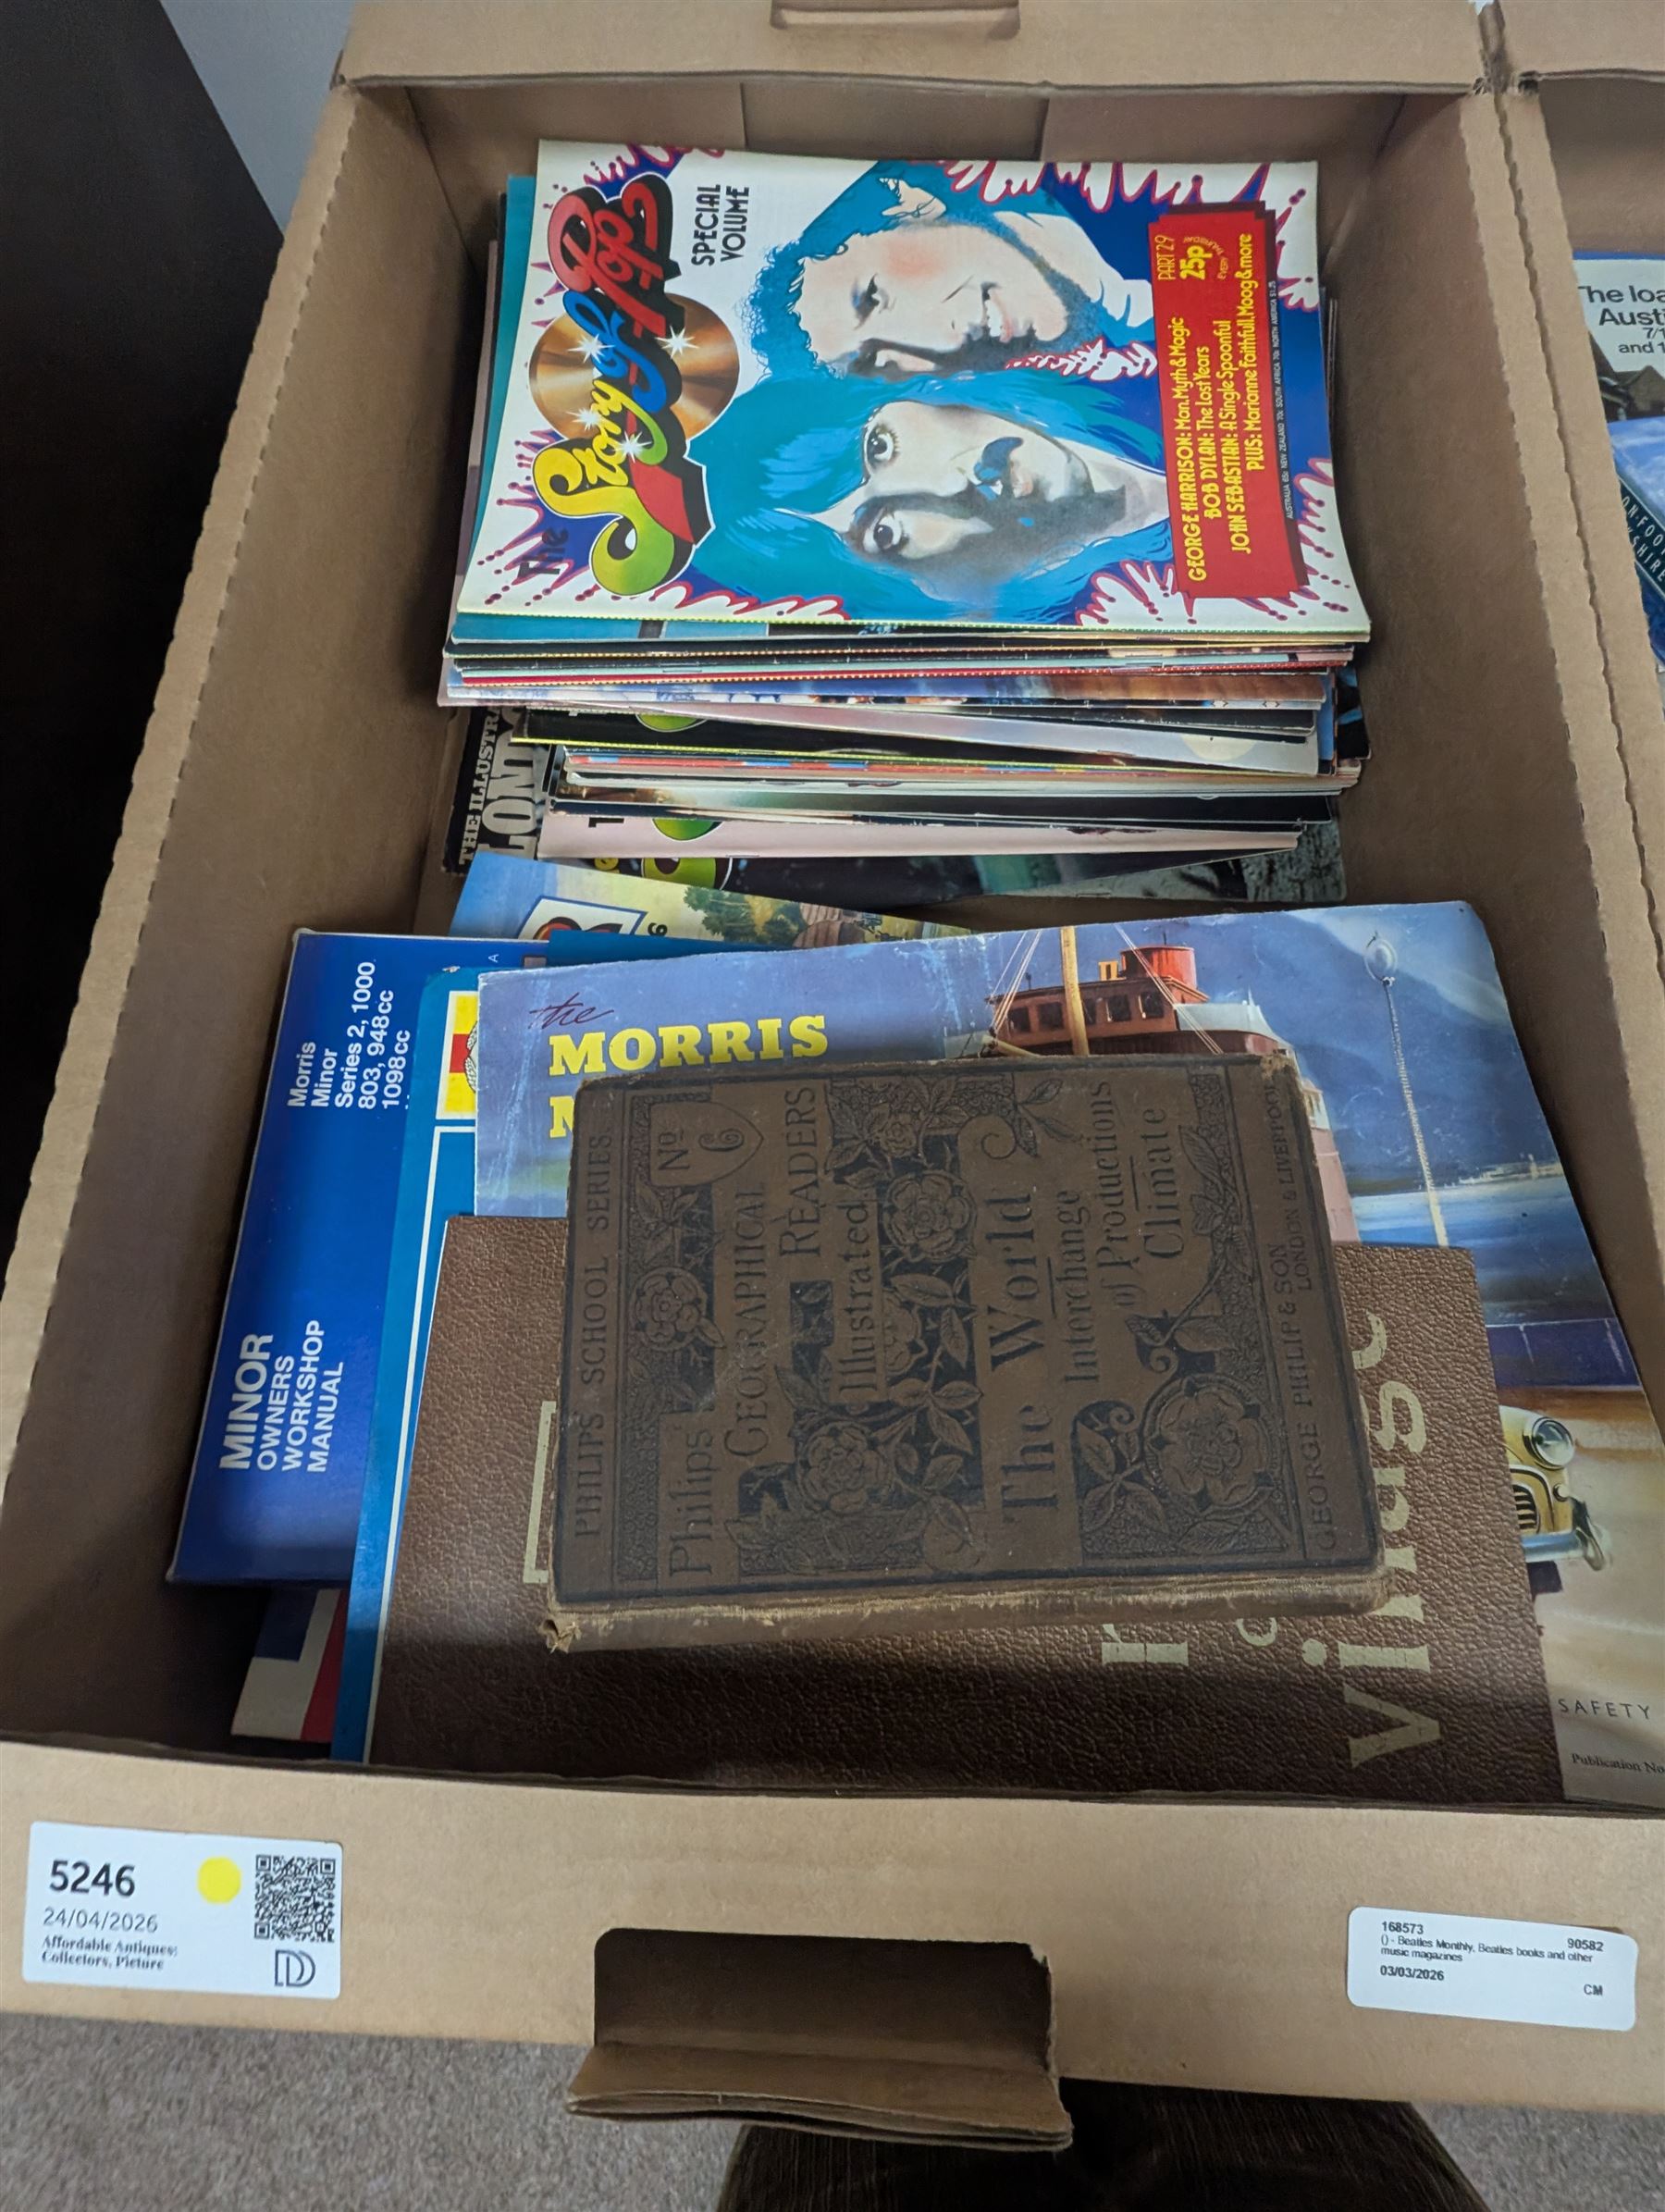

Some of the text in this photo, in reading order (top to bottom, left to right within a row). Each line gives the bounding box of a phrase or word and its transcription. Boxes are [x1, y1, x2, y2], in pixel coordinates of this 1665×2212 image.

[691, 183, 721, 266] SPECIAL
[720, 185, 750, 263] VOLUME
[1154, 234, 1177, 280] PART 29
[1179, 244, 1214, 280] 25p
[1239, 233, 1253, 272] more
[1235, 271, 1253, 280] &
[1577, 285, 1624, 303] he
[1236, 280, 1259, 316] Moog
[1269, 298, 1279, 325] AMERICA
[1167, 316, 1191, 357] Magic
[1270, 326, 1279, 348] NORTH
[1618, 341, 1655, 353] and
[1168, 358, 1188, 368] &
[1272, 362, 1282, 385] AFRICA
[518, 180, 675, 597] The Story of Pop
[1242, 369, 1263, 432] Marianne
[1274, 387, 1283, 408] SOUTH
[1192, 346, 1223, 520] BOB DYLAN: The Lost Years
[1212, 320, 1252, 555] JOHN SEBASTIAN: A Single Spoonful
[1244, 433, 1266, 471] PLUS:
[1276, 423, 1287, 452] ZEALAND
[1175, 432, 1200, 512] HARRISON:
[1279, 453, 1289, 469] NEW
[1284, 484, 1295, 519] AUSTRALIA
[1181, 513, 1207, 582] GEORGE
[459, 707, 502, 865] THE ILLUSTR
[527, 992, 614, 1029] the
[334, 962, 376, 1108] Series 2, 1000
[358, 990, 394, 1110] 803, 948cc
[549, 1014, 829, 1077] MORRIS
[287, 1042, 316, 1106] Morris
[311, 1048, 339, 1107] Minor
[381, 1030, 411, 1109] 1098cc
[697, 1127, 746, 1153] 6
[779, 1085, 822, 1259] READERS
[1141, 1106, 1185, 1261] Climate
[1089, 1081, 1139, 1309] of Productions
[1284, 1208, 1313, 1292] LONDON
[1054, 1189, 1101, 1387] Interchange
[581, 1255, 609, 1386] SCHOOL
[723, 1181, 771, 1461] GEOGRAPHICAL
[986, 1191, 1059, 1526] The World
[218, 1333, 274, 1470] MINOR
[256, 1355, 295, 1471] OWNERS
[281, 1319, 325, 1472] WORKSHOP
[1267, 1243, 1338, 1551] GEORGE PHILIP & SON
[307, 1362, 344, 1472] MANUAL
[1558, 1698, 1650, 1720] SAFETY
[1572, 1752, 1642, 1773] Publication
[49, 1859, 136, 1898] 5246
[43, 1906, 159, 1934] 24/04/2026
[1381, 1921, 1424, 1935] 168573
[42, 1935, 112, 1953] Affordable
[116, 1955, 165, 1971] Picture
[1381, 1946, 1463, 1962] music magazines
[1398, 1935, 1433, 1948] Beatles
[1478, 1943, 1513, 1956] Beatles
[1516, 1946, 1545, 1959] books
[1547, 1950, 1565, 1960] and
[1568, 1952, 1593, 1963] other
[1567, 1937, 1605, 1952] 90582
[1380, 1965, 1445, 1981] 03/03/2026
[1584, 1983, 1603, 1996] CM
